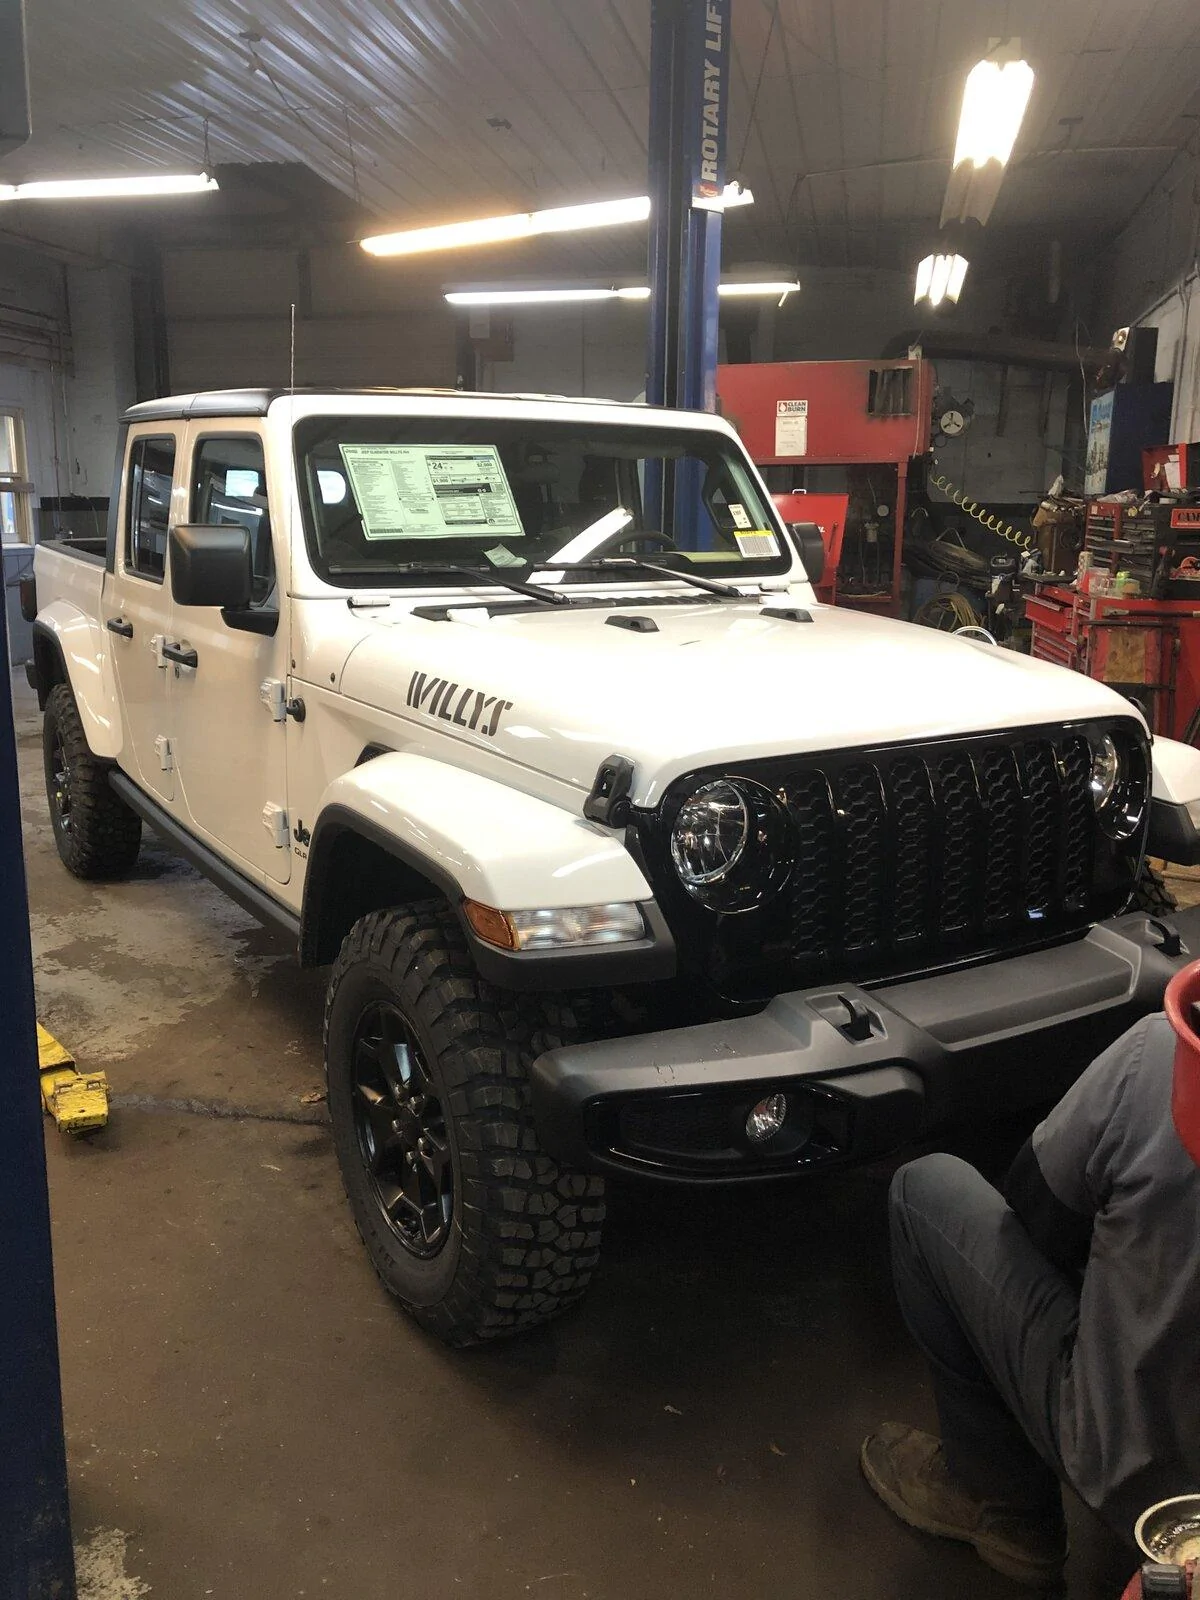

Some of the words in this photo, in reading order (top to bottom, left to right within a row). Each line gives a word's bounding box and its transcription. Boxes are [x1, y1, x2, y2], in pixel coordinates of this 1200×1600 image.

[705, 0, 722, 52] LIF
[701, 58, 720, 182] ROTARY
[431, 462, 443, 470] 24
[406, 670, 514, 737] WILLYS
